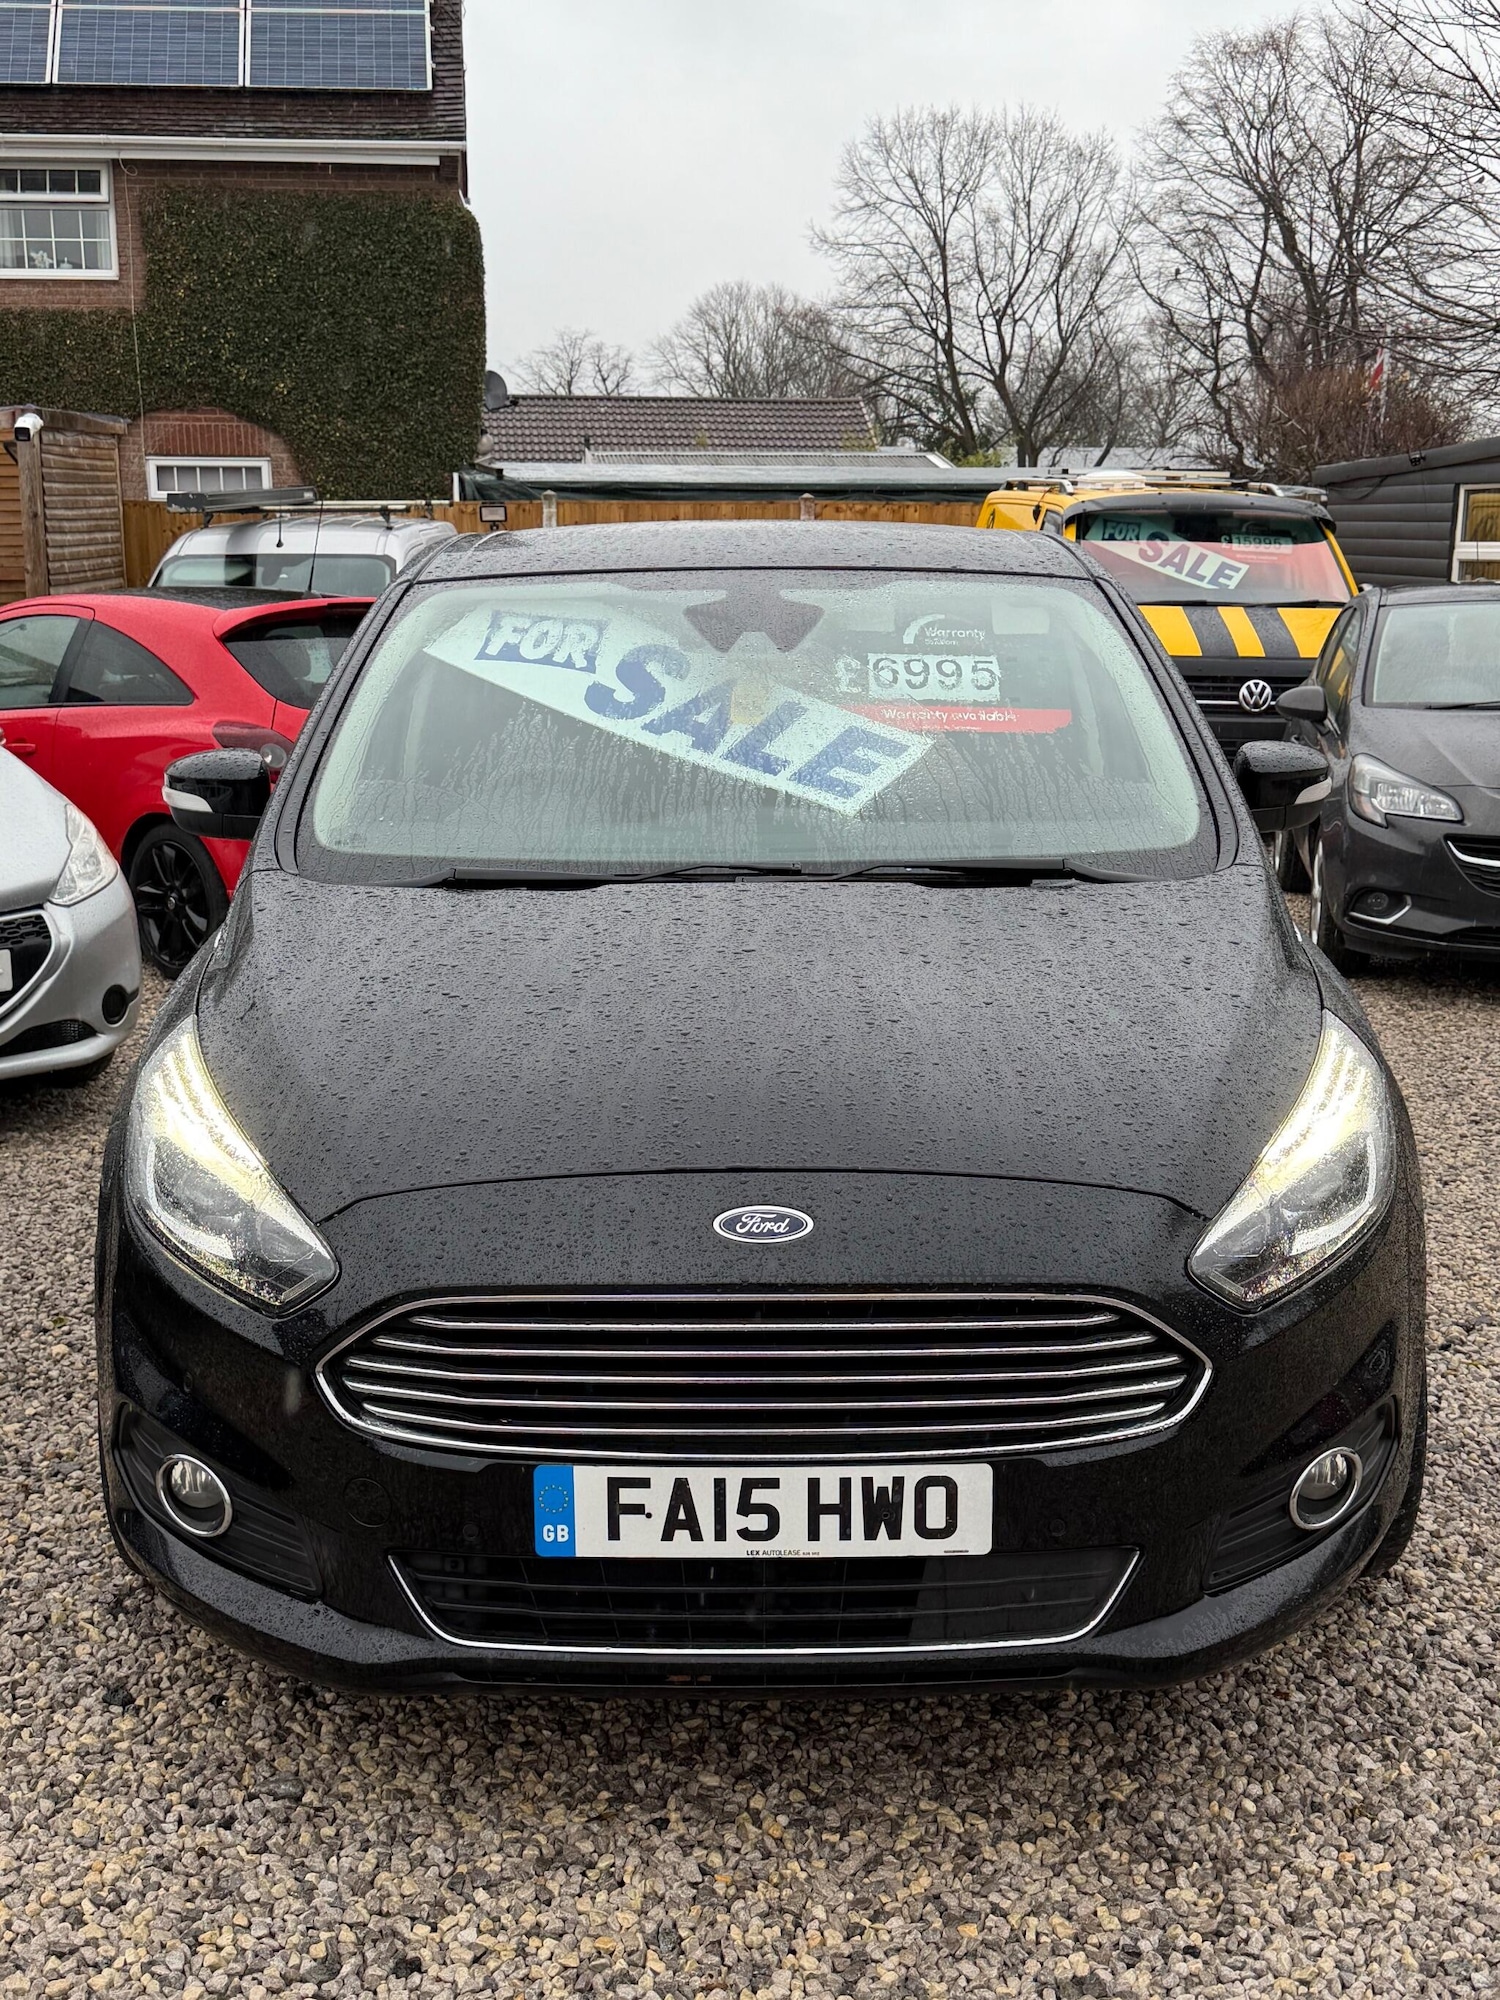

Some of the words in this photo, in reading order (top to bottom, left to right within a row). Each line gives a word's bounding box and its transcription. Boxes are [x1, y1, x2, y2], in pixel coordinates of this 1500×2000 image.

[1103, 520, 1139, 541] FOR
[1138, 531, 1242, 589] SALE
[924, 626, 986, 641] Warranty
[486, 613, 594, 669] FOR
[583, 643, 911, 800] SALE
[736, 1213, 791, 1234] Ford
[607, 1476, 782, 1542] FA15
[806, 1475, 959, 1542] HWO
[542, 1524, 570, 1543] GB
